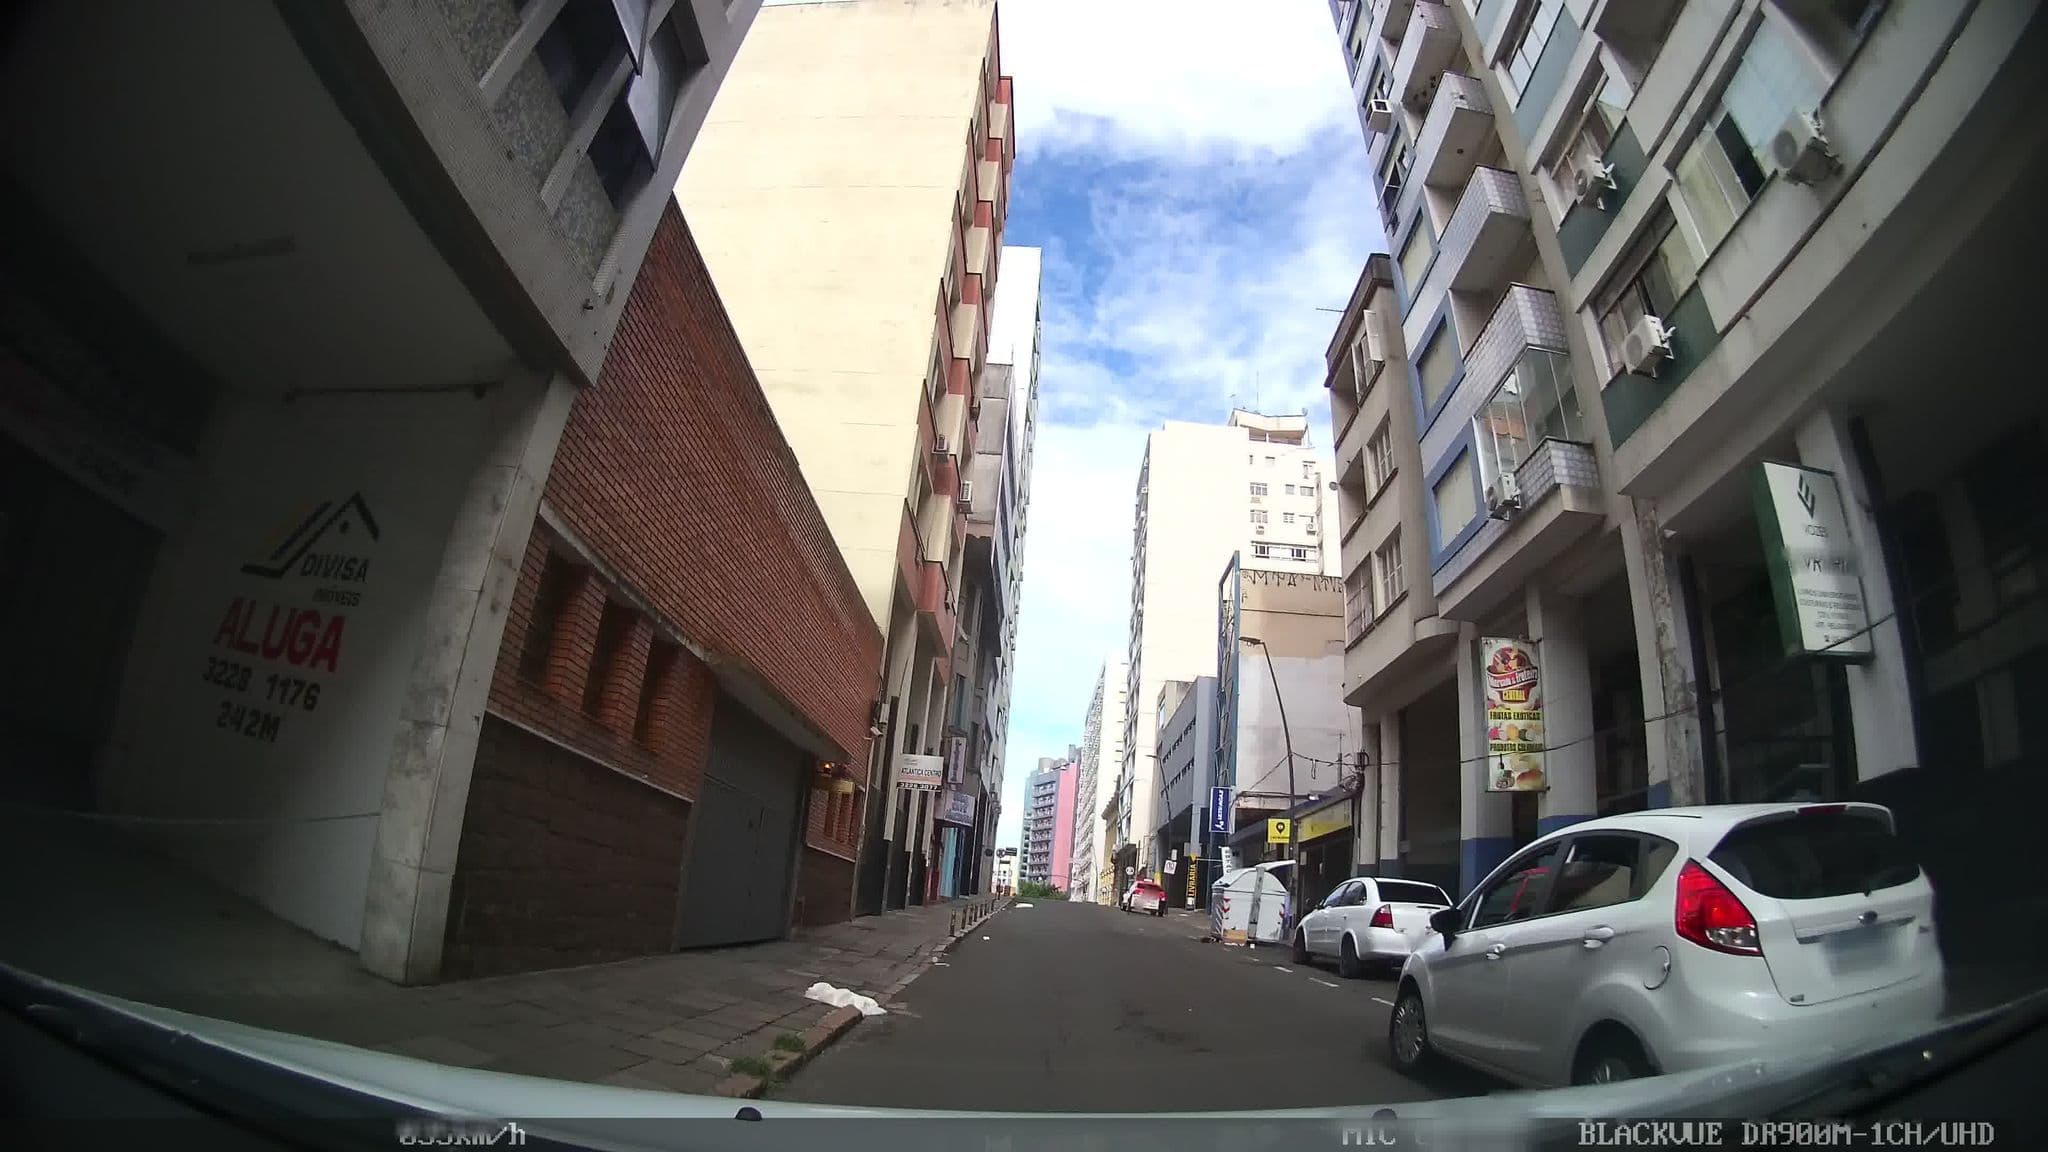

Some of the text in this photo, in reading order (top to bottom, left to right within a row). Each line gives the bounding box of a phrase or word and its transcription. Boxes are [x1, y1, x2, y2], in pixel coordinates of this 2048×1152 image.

[300, 553, 369, 583] DIVISA
[213, 596, 346, 673] ALUGA
[202, 656, 321, 712] 3228 1176
[1490, 711, 1512, 720] FRUTAS
[1188, 864, 1197, 897] LIVRARIA
